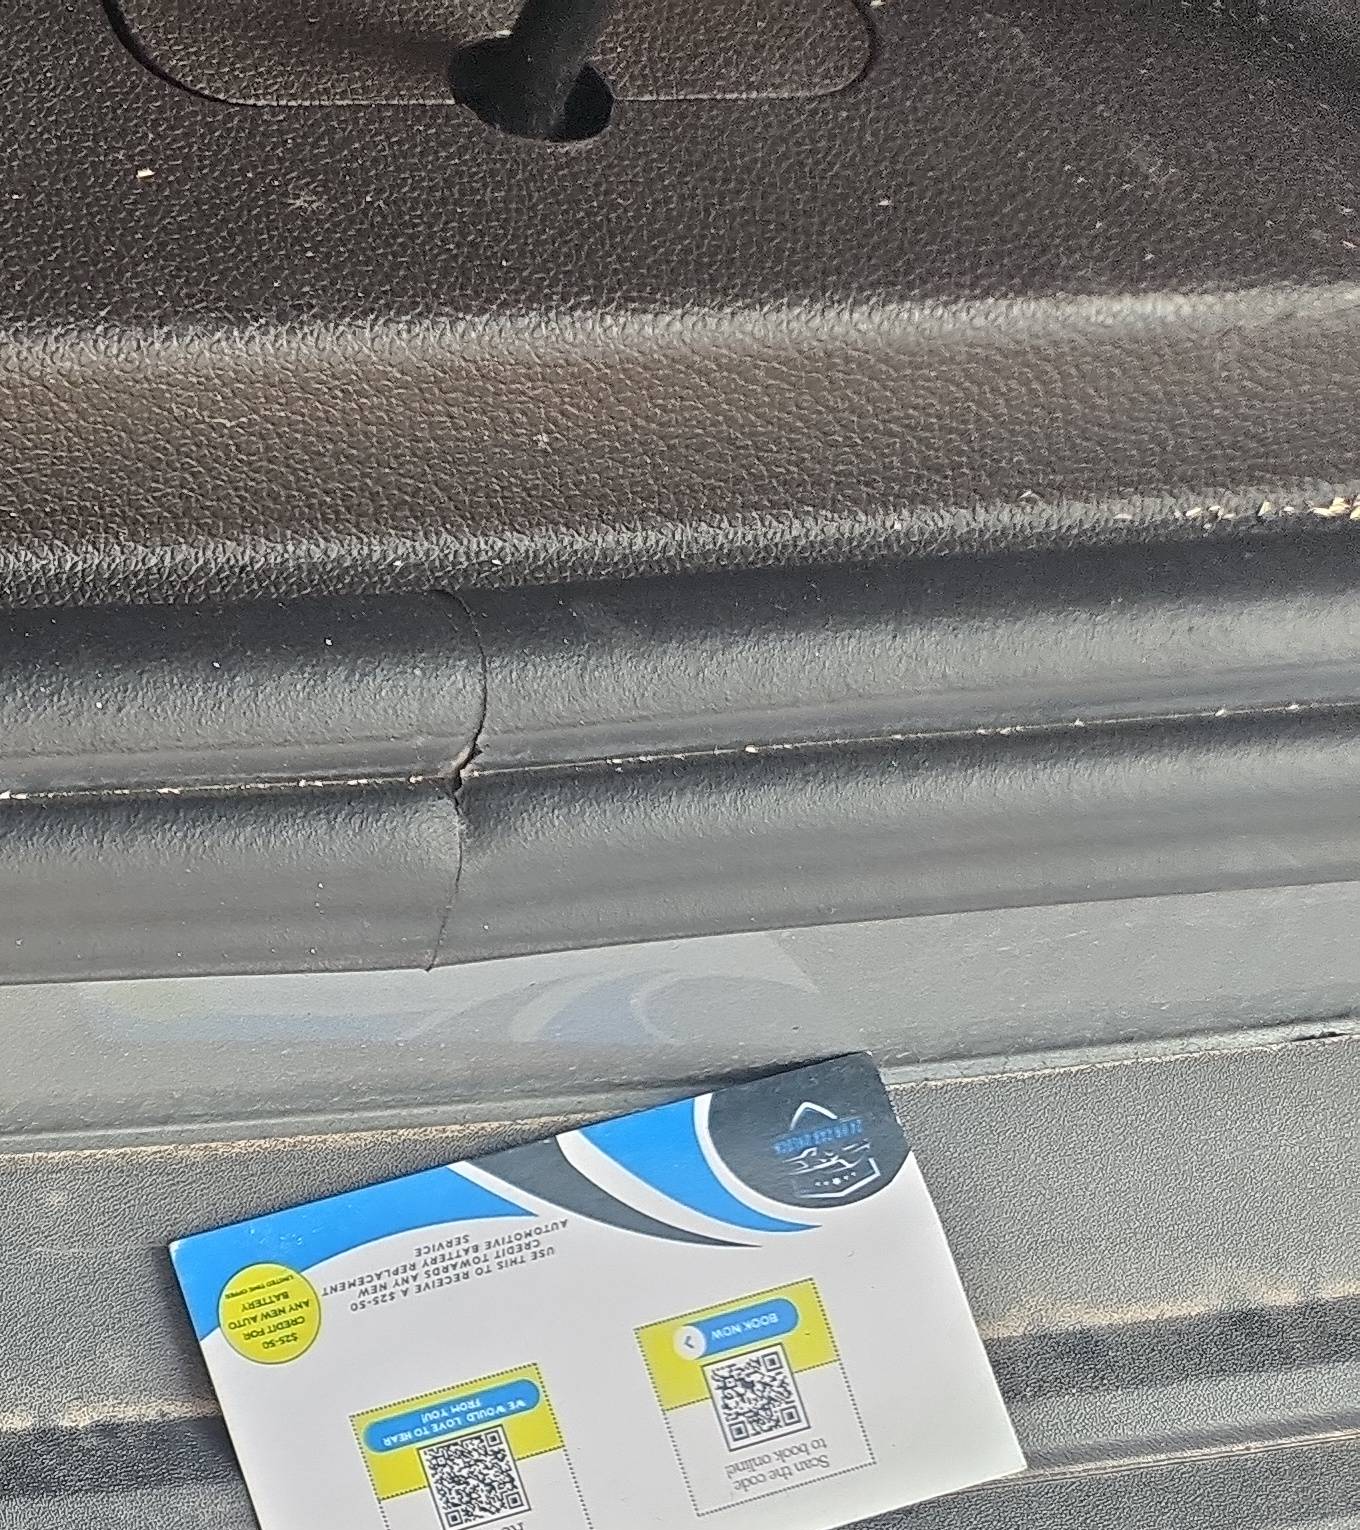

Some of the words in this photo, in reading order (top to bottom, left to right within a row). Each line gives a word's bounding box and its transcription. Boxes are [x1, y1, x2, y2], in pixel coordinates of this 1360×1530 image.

[483, 1219, 568, 1248] AUTOMOTIVE
[413, 1234, 470, 1256] SERVICE
[492, 1239, 540, 1258] CREDIT
[420, 1244, 479, 1266] BATTERY
[530, 1247, 553, 1259] USE
[424, 1254, 488, 1277] TOWARDS
[496, 1255, 525, 1268] THIS
[474, 1265, 490, 1275] TO
[320, 1262, 416, 1295] REPLACEMENT
[391, 1273, 419, 1286] ANY
[413, 1271, 469, 1292] RECEIVE
[356, 1282, 387, 1296] NEW
[400, 1288, 409, 1296] A
[240, 1291, 289, 1311] BATTERY
[287, 1299, 310, 1311] ANY
[349, 1291, 395, 1310] $25-50
[259, 1307, 286, 1319] NEW
[227, 1315, 258, 1329] AUTO
[265, 1316, 305, 1332] CREDIT
[743, 1313, 777, 1329] BOOK
[242, 1328, 264, 1339] FOR
[711, 1324, 741, 1338] NOW
[261, 1333, 297, 1348] $25-50
[450, 1398, 480, 1413] FROM
[507, 1398, 526, 1409] WE
[420, 1407, 447, 1422] YOU!
[465, 1404, 505, 1421] WOULD
[413, 1426, 428, 1436] TO
[431, 1417, 461, 1431] LOVE
[382, 1431, 412, 1445] HEAR
[811, 1439, 825, 1449] to
[774, 1444, 809, 1462] book
[725, 1455, 771, 1477] online!
[794, 1455, 828, 1474] Scan
[768, 1466, 791, 1482] the
[733, 1474, 766, 1492] code
